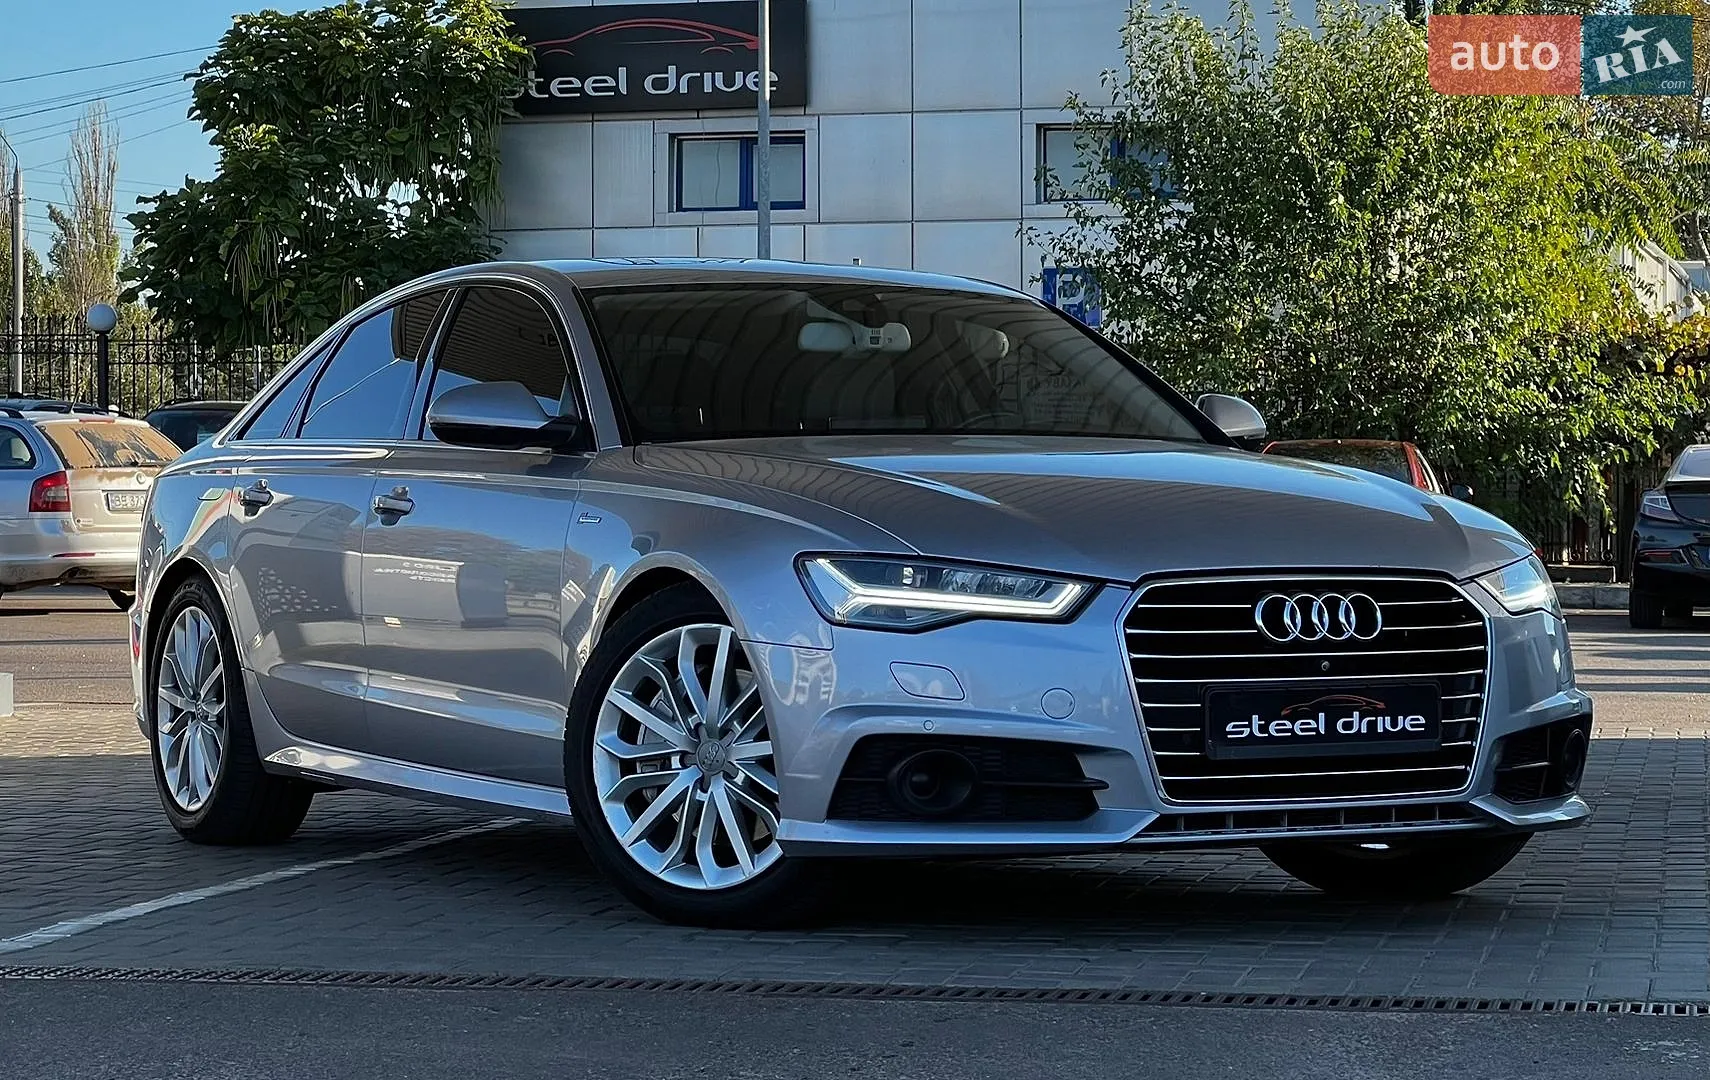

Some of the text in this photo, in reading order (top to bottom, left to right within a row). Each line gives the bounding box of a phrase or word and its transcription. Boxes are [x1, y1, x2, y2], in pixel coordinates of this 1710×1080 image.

[643, 65, 778, 95] drive
[1225, 711, 1426, 738] steel drive
